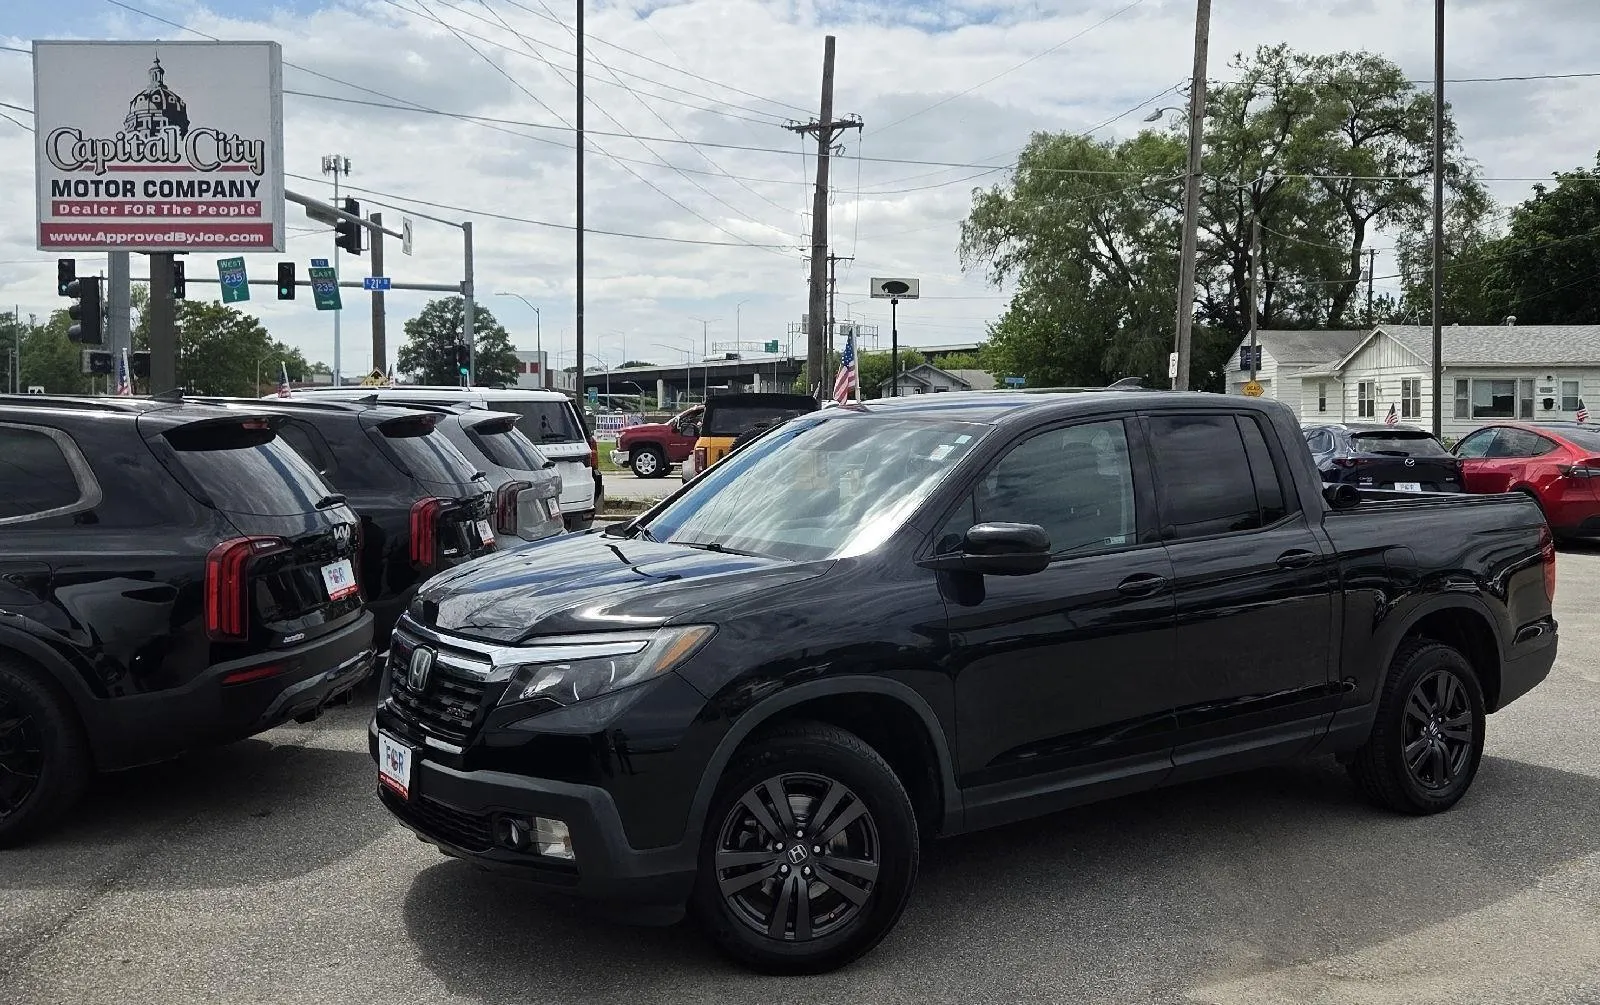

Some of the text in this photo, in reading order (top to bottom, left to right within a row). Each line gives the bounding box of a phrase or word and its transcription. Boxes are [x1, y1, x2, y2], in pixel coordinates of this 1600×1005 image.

[46, 127, 265, 176] Capital City
[51, 179, 261, 198] MOTOR COMPANY
[59, 203, 256, 217] Dealer FOR The People
[49, 231, 264, 243] www.ApprovedByJoe.com
[220, 260, 242, 268] WEST
[224, 272, 243, 283] 235
[311, 270, 332, 278] EAST
[317, 282, 336, 292] 235
